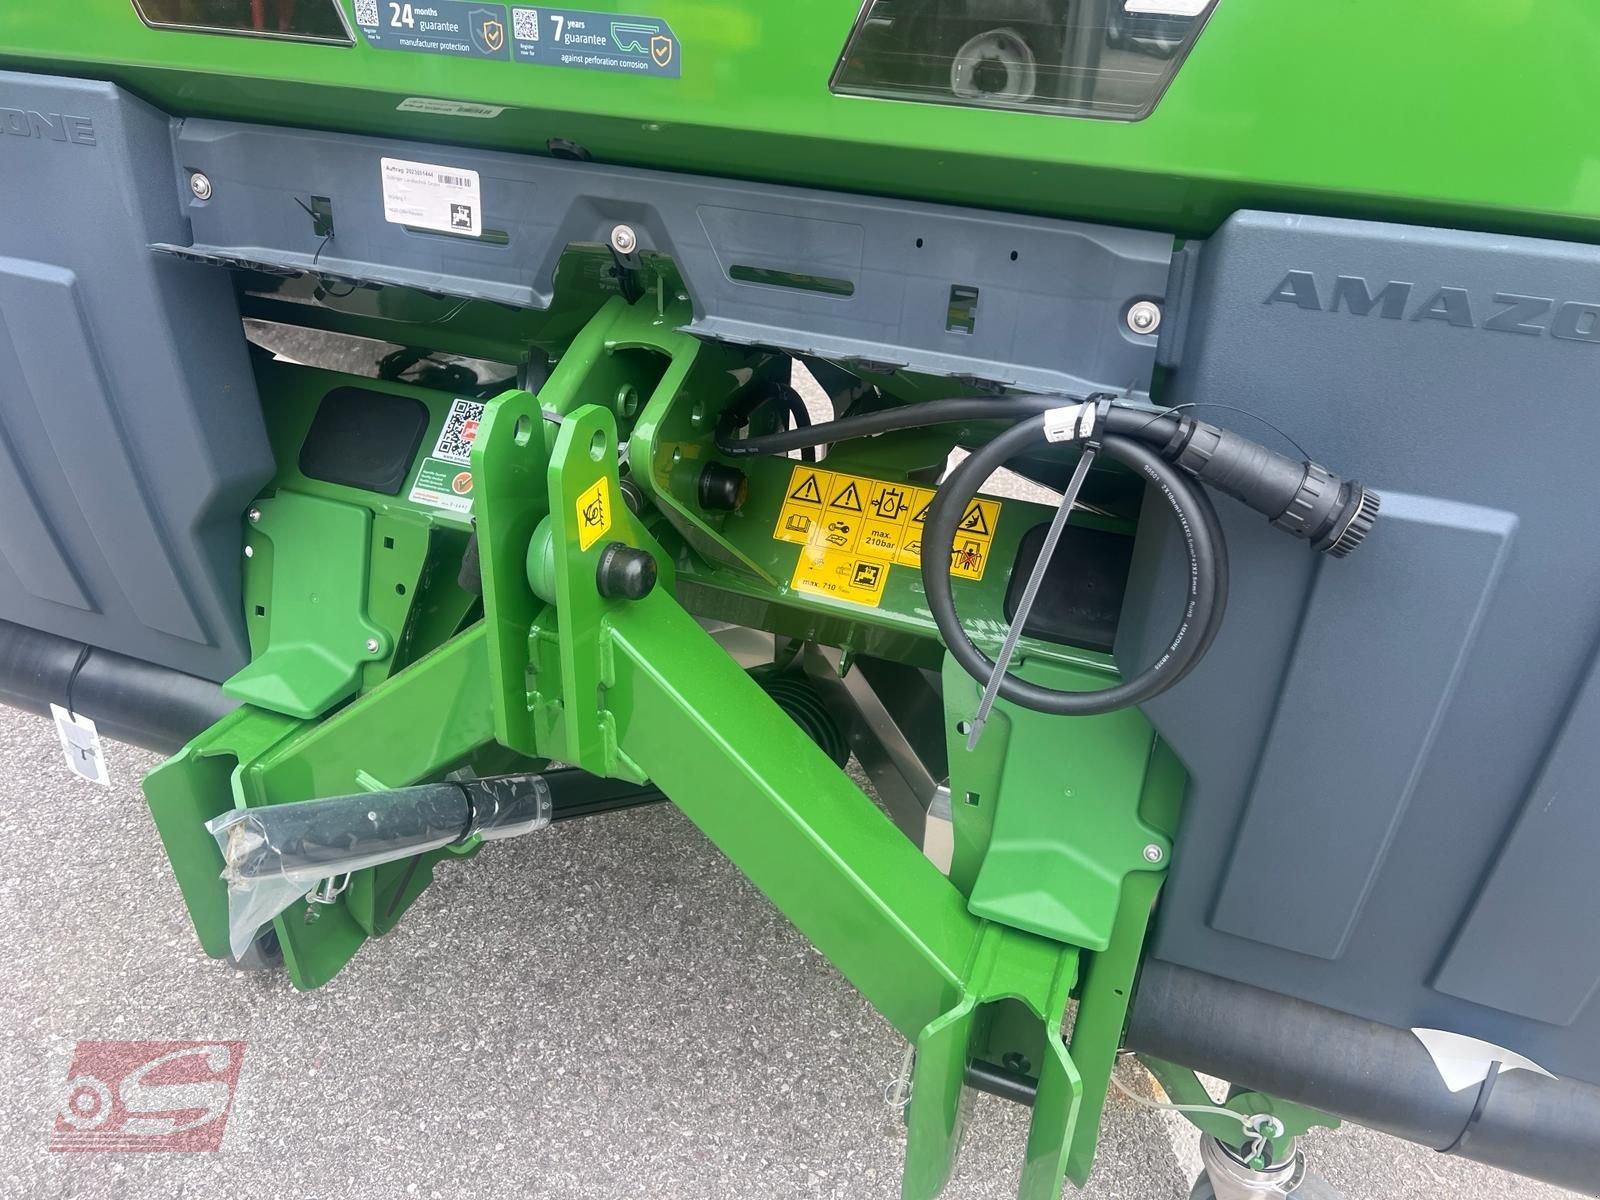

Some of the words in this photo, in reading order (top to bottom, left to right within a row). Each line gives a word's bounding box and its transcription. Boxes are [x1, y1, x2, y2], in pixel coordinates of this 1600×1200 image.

[389, 2, 415, 28] 24
[414, 7, 438, 17] months
[420, 20, 459, 32] guarantee
[550, 15, 564, 42] 7
[567, 20, 585, 29] years
[399, 38, 439, 49] manufacturer
[440, 42, 470, 52] protection
[564, 33, 606, 46] guarantee
[560, 53, 584, 64] against
[584, 55, 618, 66] perforation
[619, 58, 648, 69] corrosion
[0, 107, 97, 147] ONE
[871, 529, 892, 540] max.
[865, 537, 896, 550] 210bar
[802, 579, 821, 588] max.
[822, 582, 836, 591] 710
[1170, 622, 1189, 651] AMAZONE
